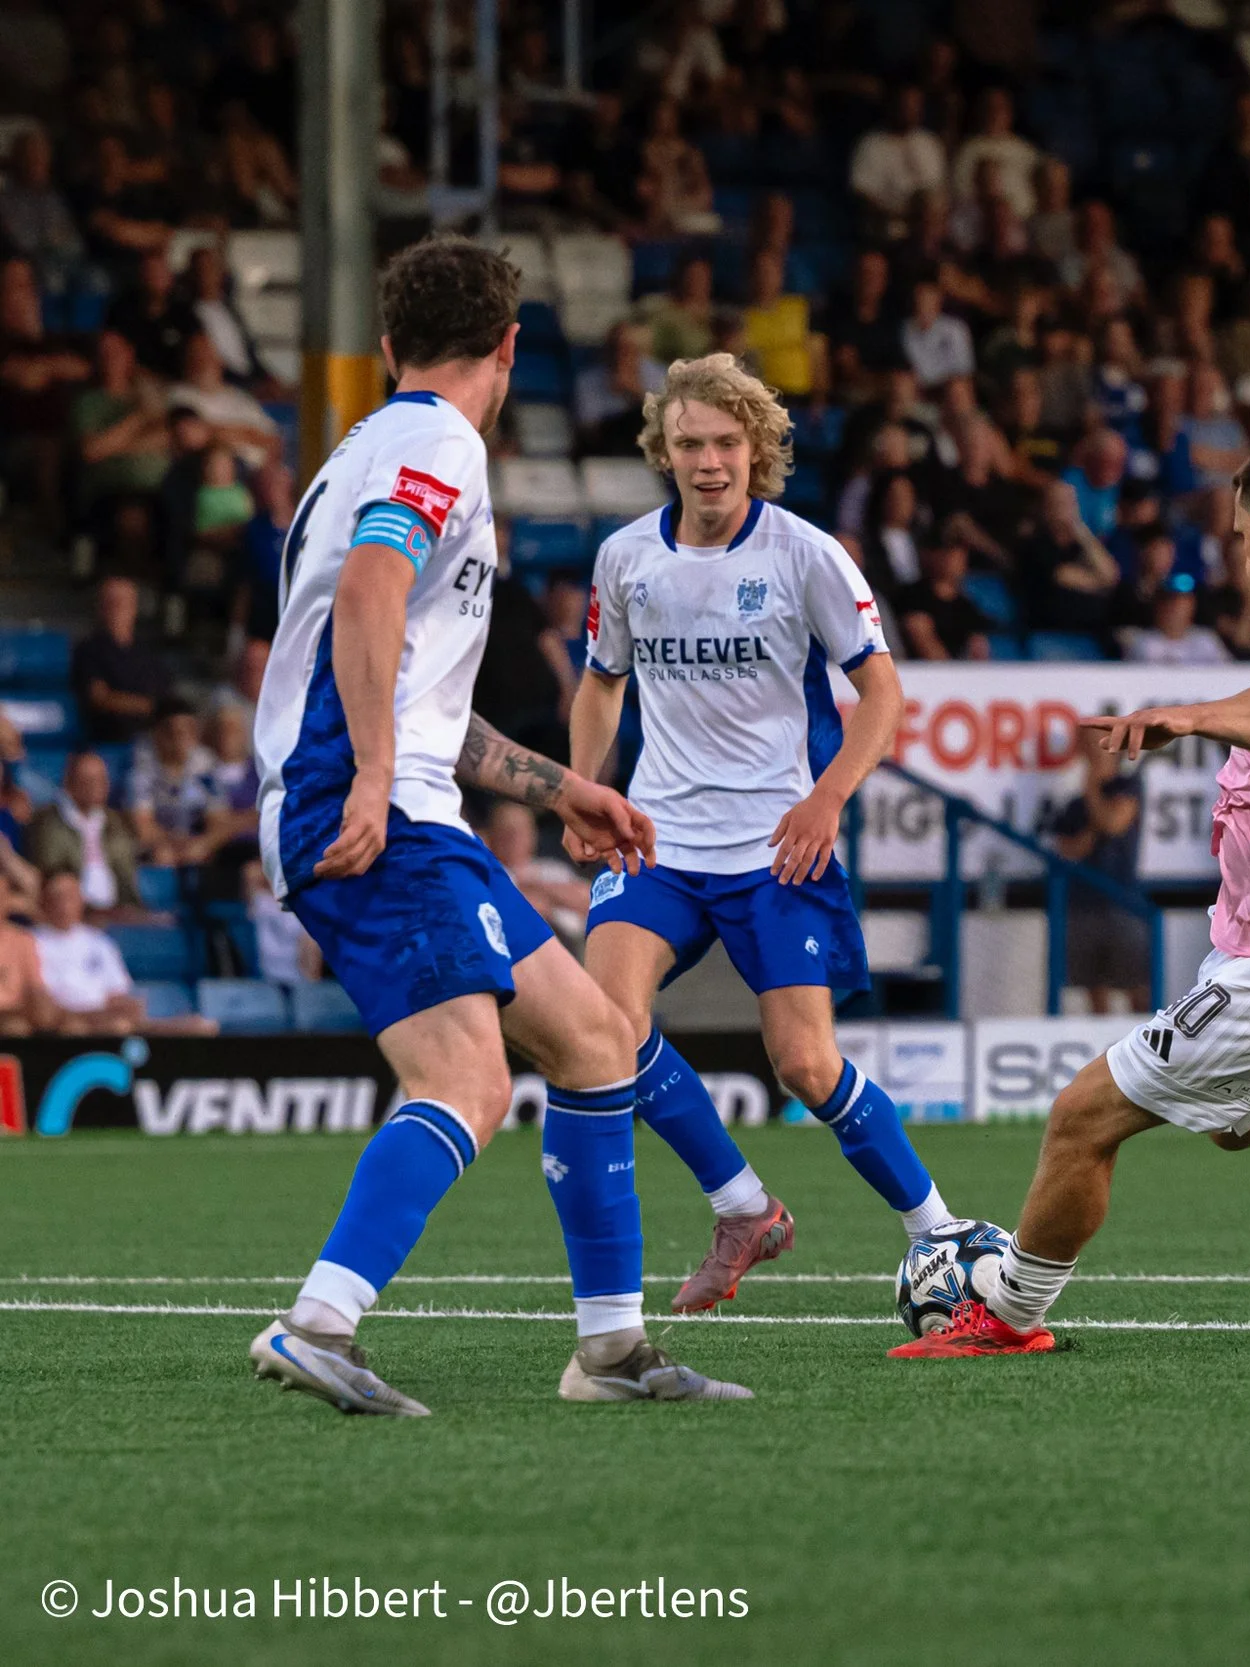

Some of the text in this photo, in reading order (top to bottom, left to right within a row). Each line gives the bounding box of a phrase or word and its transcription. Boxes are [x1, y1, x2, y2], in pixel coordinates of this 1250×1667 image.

[405, 525, 427, 557] C
[459, 600, 485, 618] SU
[634, 636, 771, 664] EYELEVEL
[648, 665, 758, 681] SUNGLASSES
